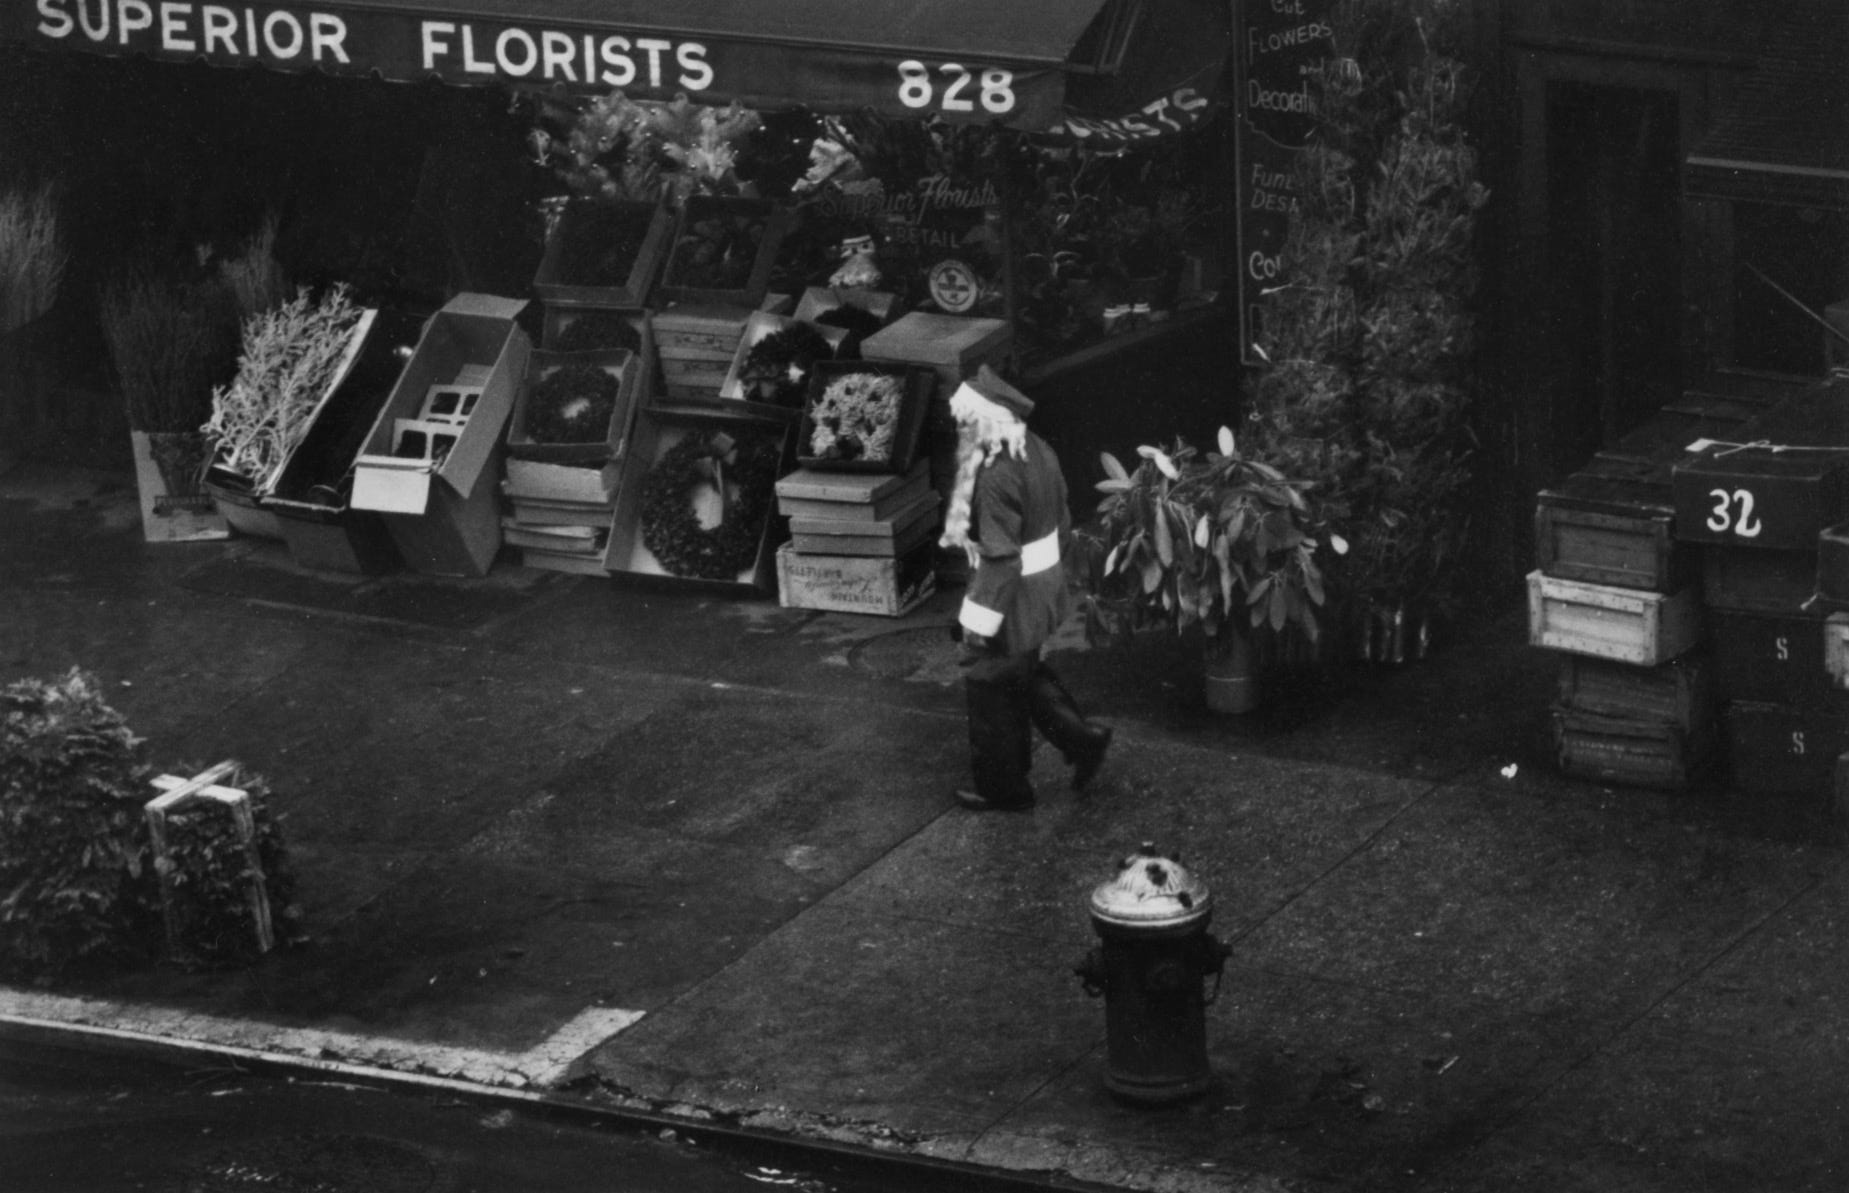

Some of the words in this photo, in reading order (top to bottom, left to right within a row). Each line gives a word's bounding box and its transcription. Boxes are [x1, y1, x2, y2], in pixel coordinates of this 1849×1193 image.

[36, 0, 350, 63] SUPERIOR
[421, 21, 713, 91] FLORISTS
[897, 60, 1015, 113] 828
[1706, 489, 1762, 537] 32
